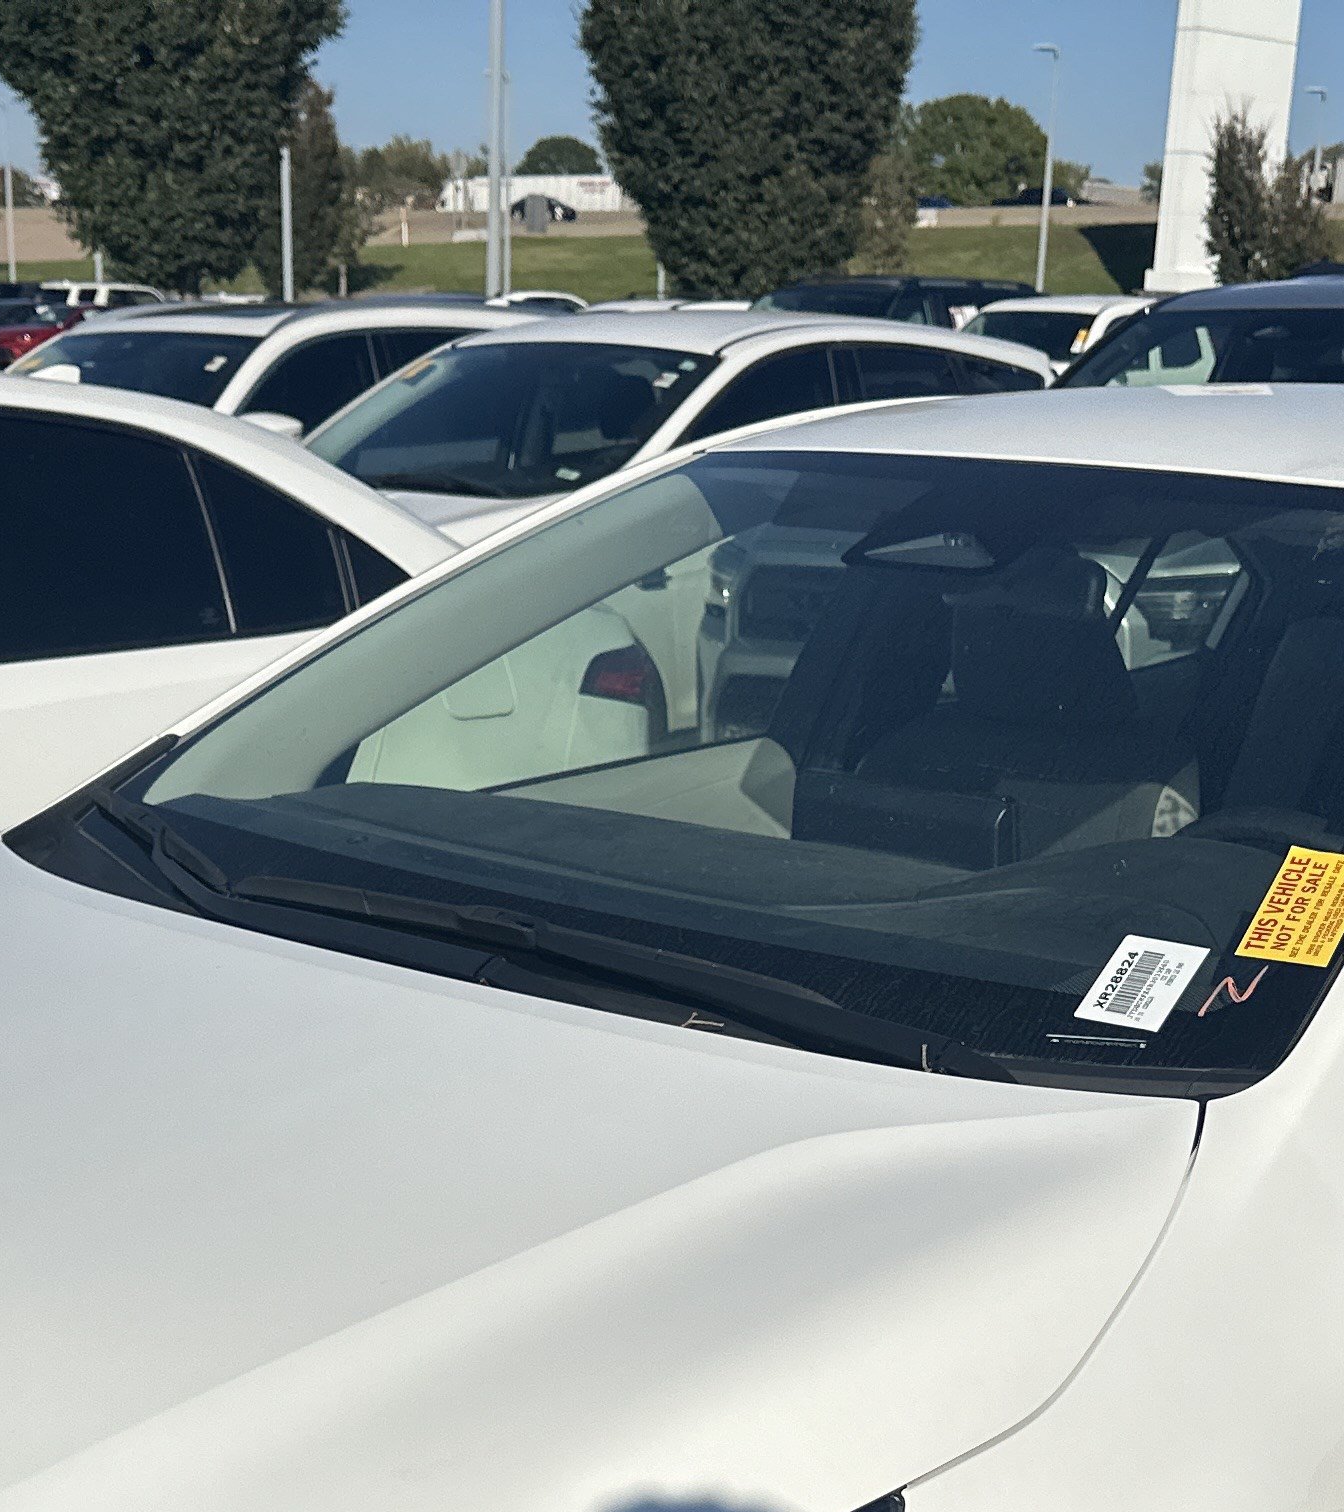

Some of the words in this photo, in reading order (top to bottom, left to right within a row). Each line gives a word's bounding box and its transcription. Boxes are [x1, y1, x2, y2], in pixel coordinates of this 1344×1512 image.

[1244, 918, 1278, 950] THIS
[1263, 856, 1312, 914] VEHICLE
[1270, 925, 1296, 952] NOT
[1285, 897, 1312, 923] FOR
[1301, 862, 1330, 894] SALE
[1289, 946, 1301, 959] SEE
[1295, 934, 1307, 946] THE
[1302, 911, 1318, 934] DEALER
[1320, 876, 1337, 897] RESALE
[1093, 951, 1139, 1009] XR28824
